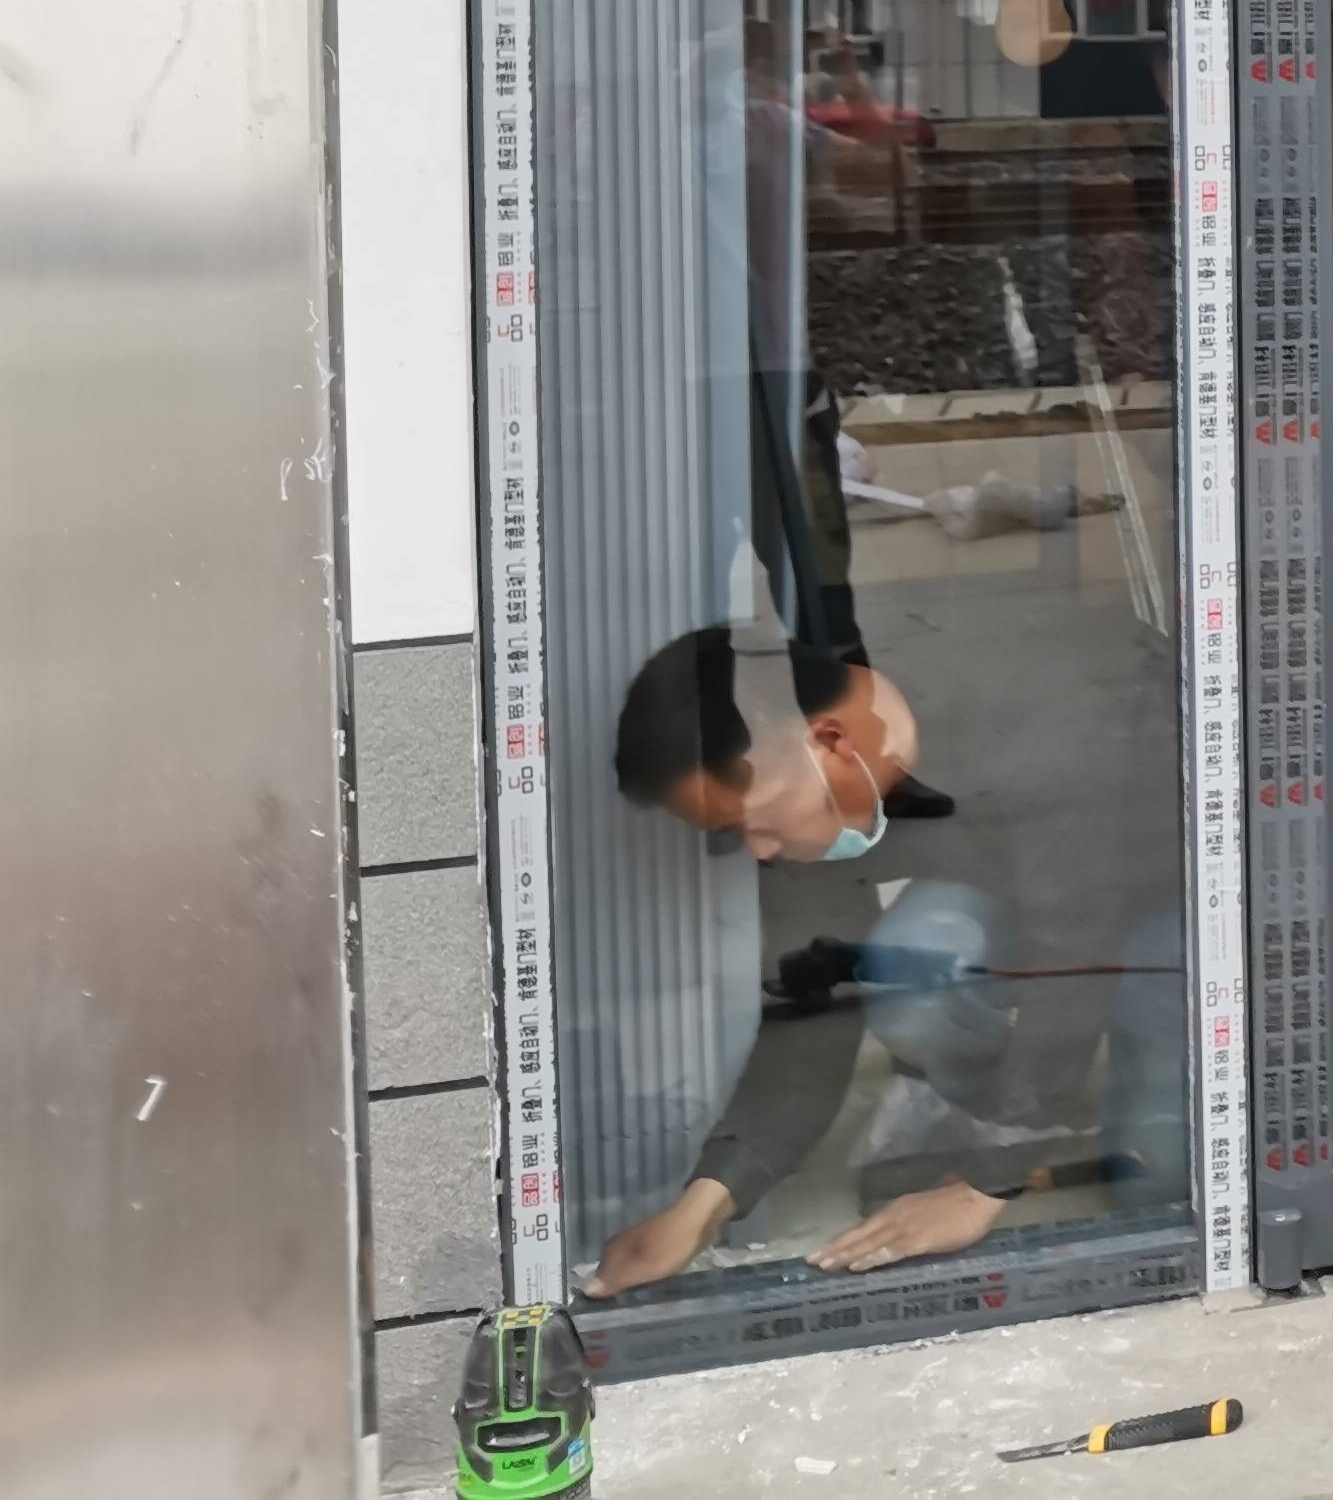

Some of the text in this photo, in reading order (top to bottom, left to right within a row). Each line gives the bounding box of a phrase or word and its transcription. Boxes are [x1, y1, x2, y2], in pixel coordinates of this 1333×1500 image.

[496, 22, 517, 220] 折叠门、感应自动门、肯德基门型材
[1199, 257, 1216, 438] 折叠门、感应自动门、肯德基门型材
[505, 477, 527, 673] 折叠门、感应自动门、肯德基门型材
[1205, 675, 1223, 856] 折叠门、感应自动门、肯德基门型材
[517, 928, 539, 1122] 折叠门、感应自动门、肯德基门型材
[1212, 1092, 1230, 1271] 折叠门、感应自动门、肯德基门型材
